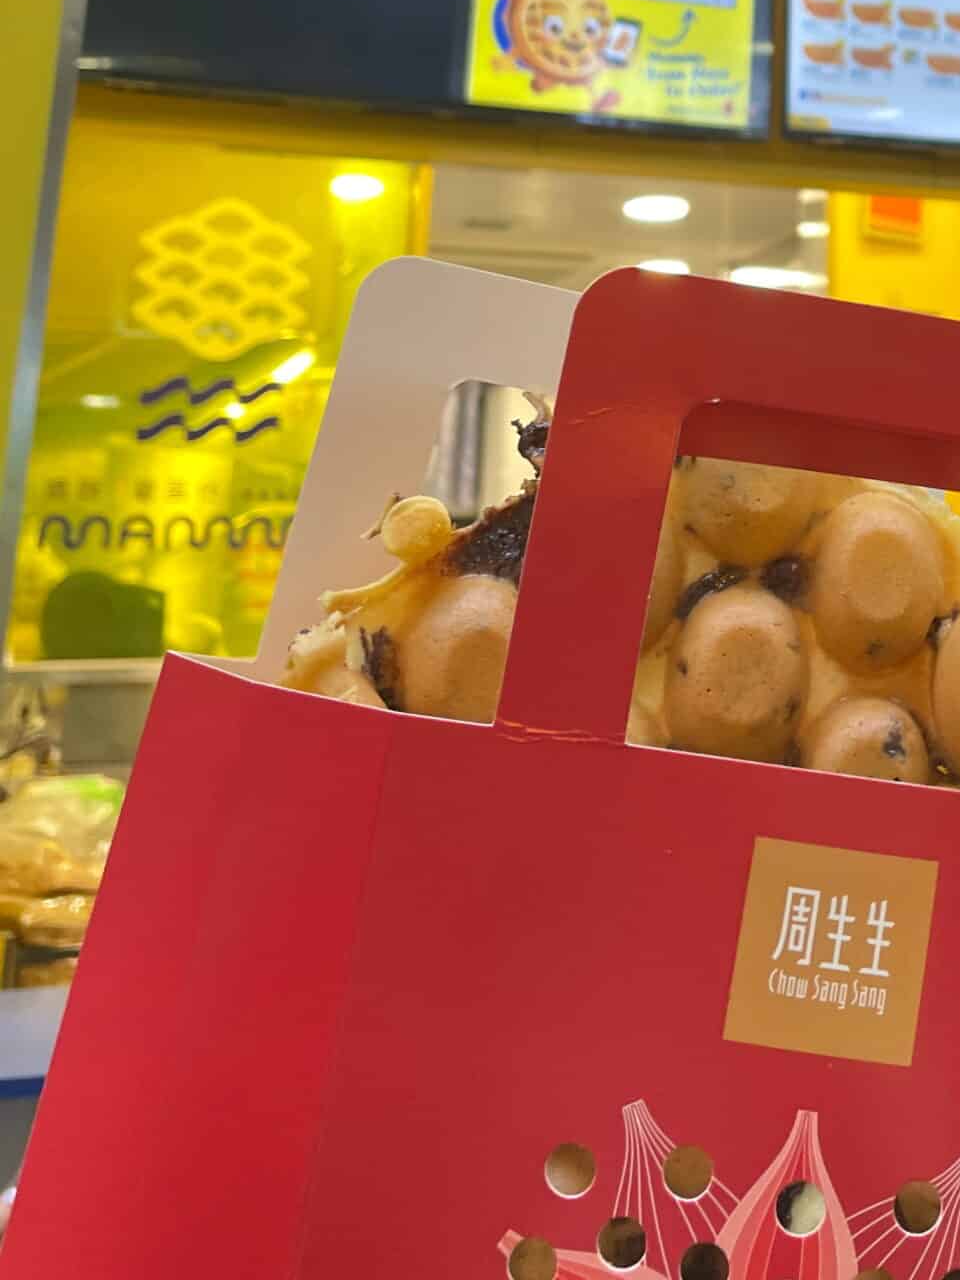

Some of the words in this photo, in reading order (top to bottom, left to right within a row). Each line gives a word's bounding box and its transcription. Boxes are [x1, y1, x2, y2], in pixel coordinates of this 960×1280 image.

[771, 886, 895, 977] 周生生
[768, 968, 808, 999] Chow
[811, 974, 849, 1010] Sang
[851, 979, 888, 1016] Sang
